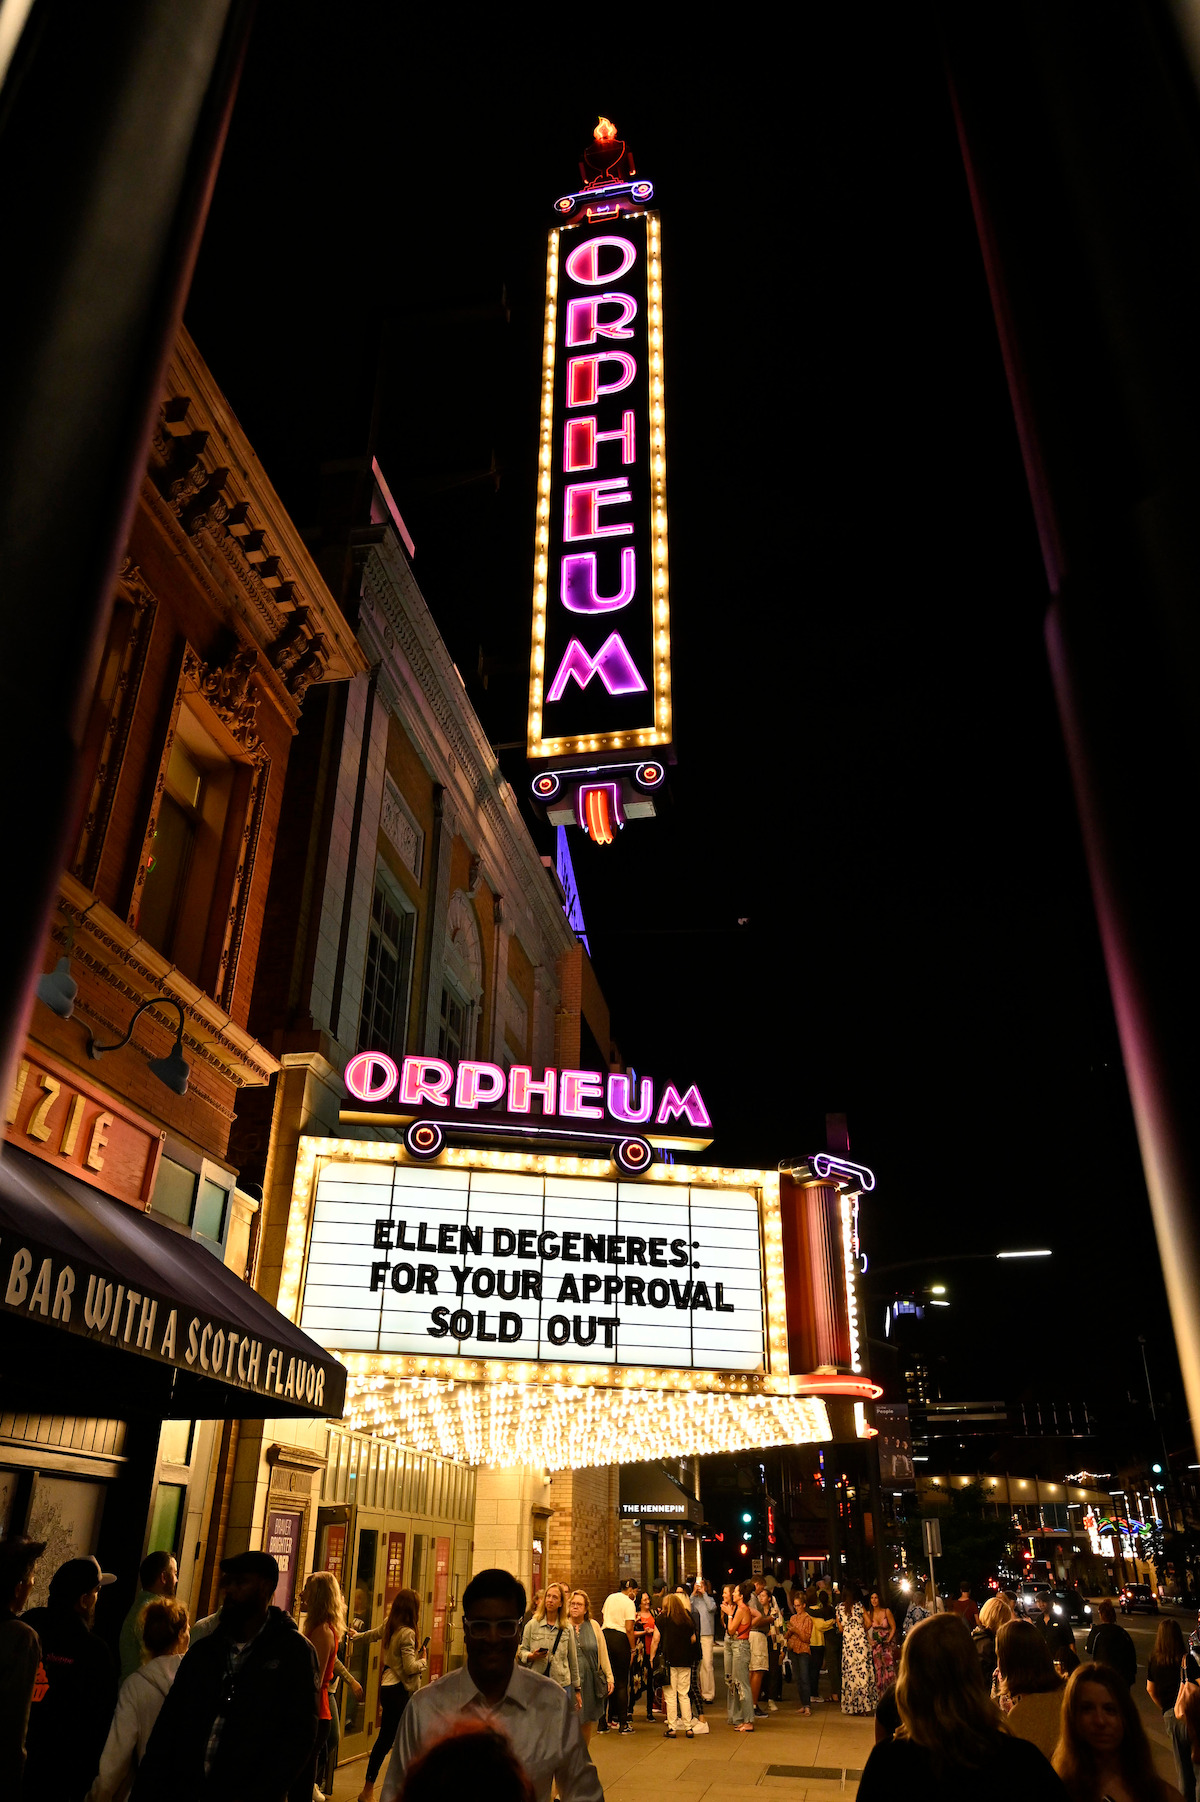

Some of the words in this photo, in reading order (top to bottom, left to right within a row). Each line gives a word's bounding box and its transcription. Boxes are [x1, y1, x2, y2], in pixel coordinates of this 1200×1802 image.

[546, 235, 648, 703] ORPHEUM
[344, 1050, 713, 1128] ORPHEUM
[373, 1218, 484, 1256] ELLEN
[493, 1227, 701, 1269] DEGENERES:
[369, 1261, 439, 1296] FOR
[450, 1265, 543, 1301] YOUR
[556, 1272, 735, 1312] APPROVAL
[5, 1247, 76, 1323] BAR
[84, 1274, 158, 1351] WITH
[160, 1309, 178, 1360] A
[185, 1316, 263, 1385] SCOTCH
[265, 1348, 326, 1407] FLAVOR
[426, 1306, 523, 1344] SOLD
[547, 1314, 621, 1349] OUT
[623, 1504, 639, 1513] THE
[640, 1504, 685, 1513] HENNEPIN
[269, 1536, 293, 1554] BRIGHTER
